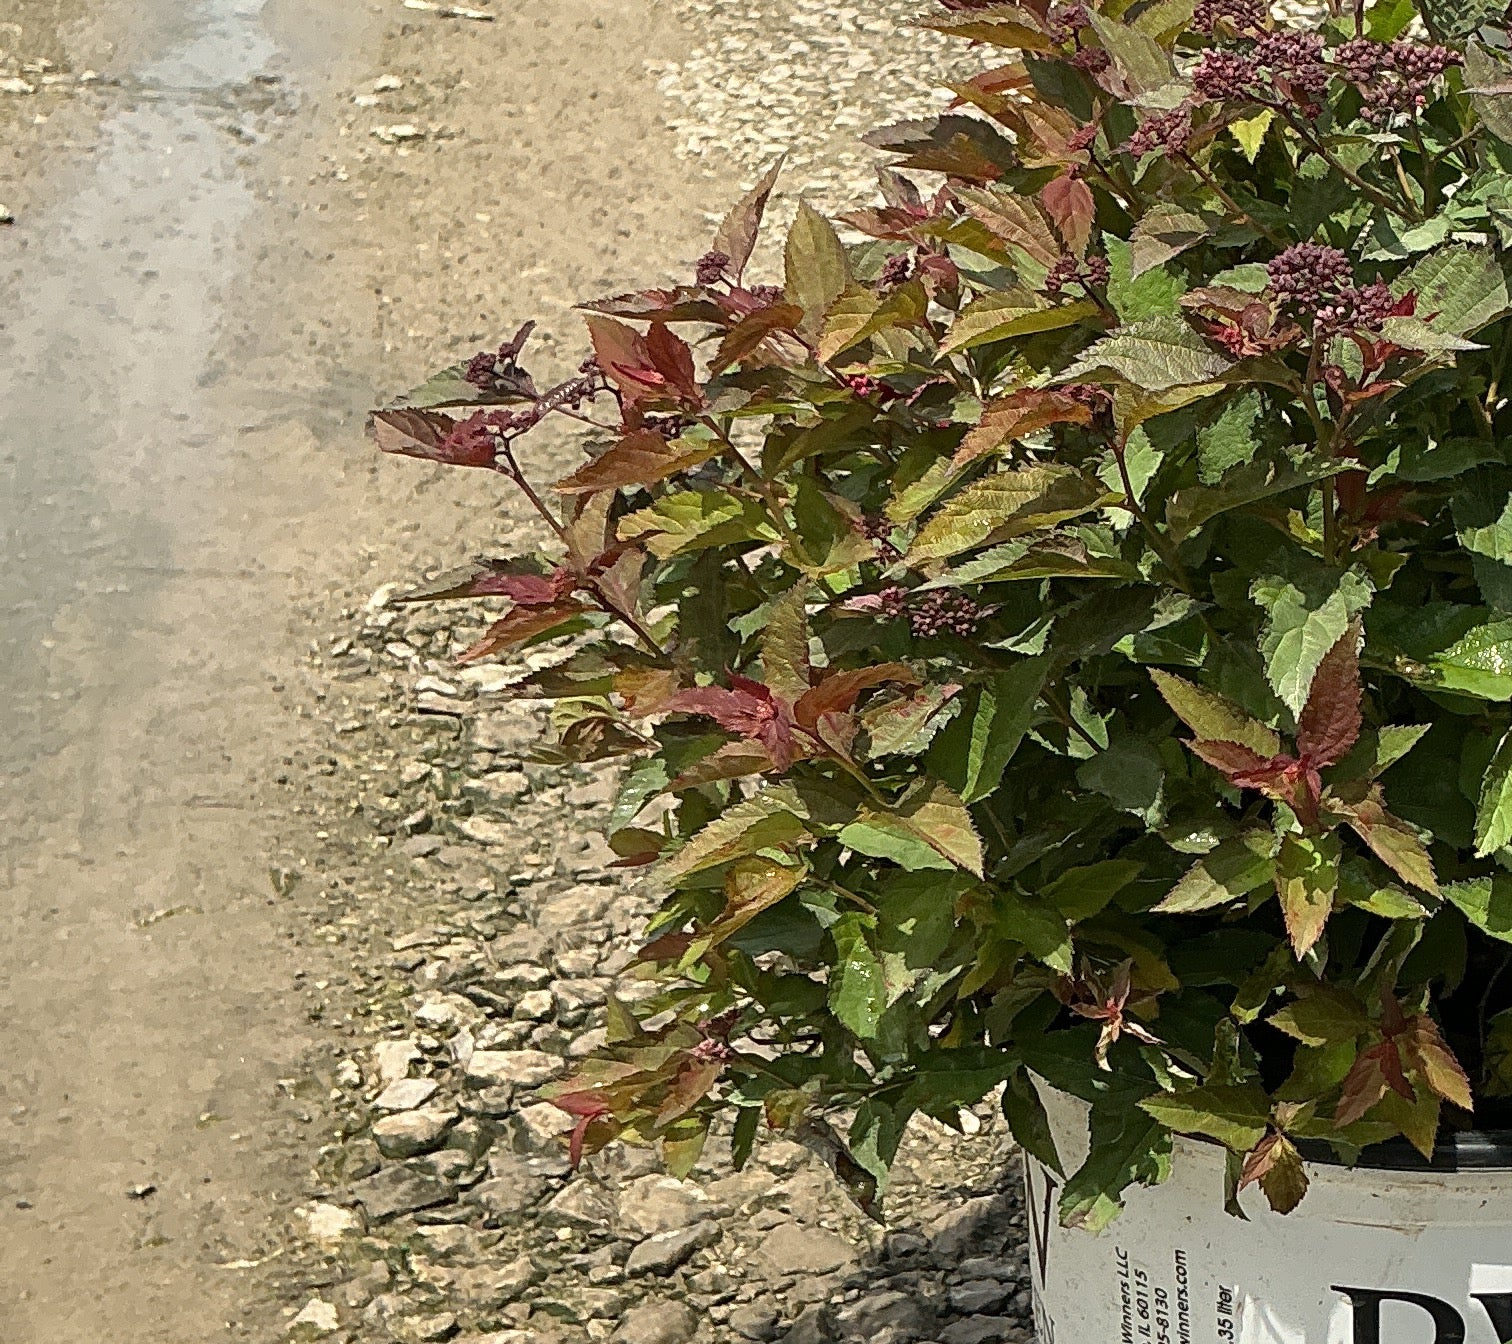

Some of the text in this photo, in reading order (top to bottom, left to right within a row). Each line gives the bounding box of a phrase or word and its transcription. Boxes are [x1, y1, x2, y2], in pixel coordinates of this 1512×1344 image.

[1115, 1246, 1130, 1279] LLC
[1134, 1268, 1150, 1320] 60115
[1216, 1284, 1234, 1316] liter
[1117, 1281, 1134, 1344] Winners
[1137, 1323, 1151, 1338] IL
